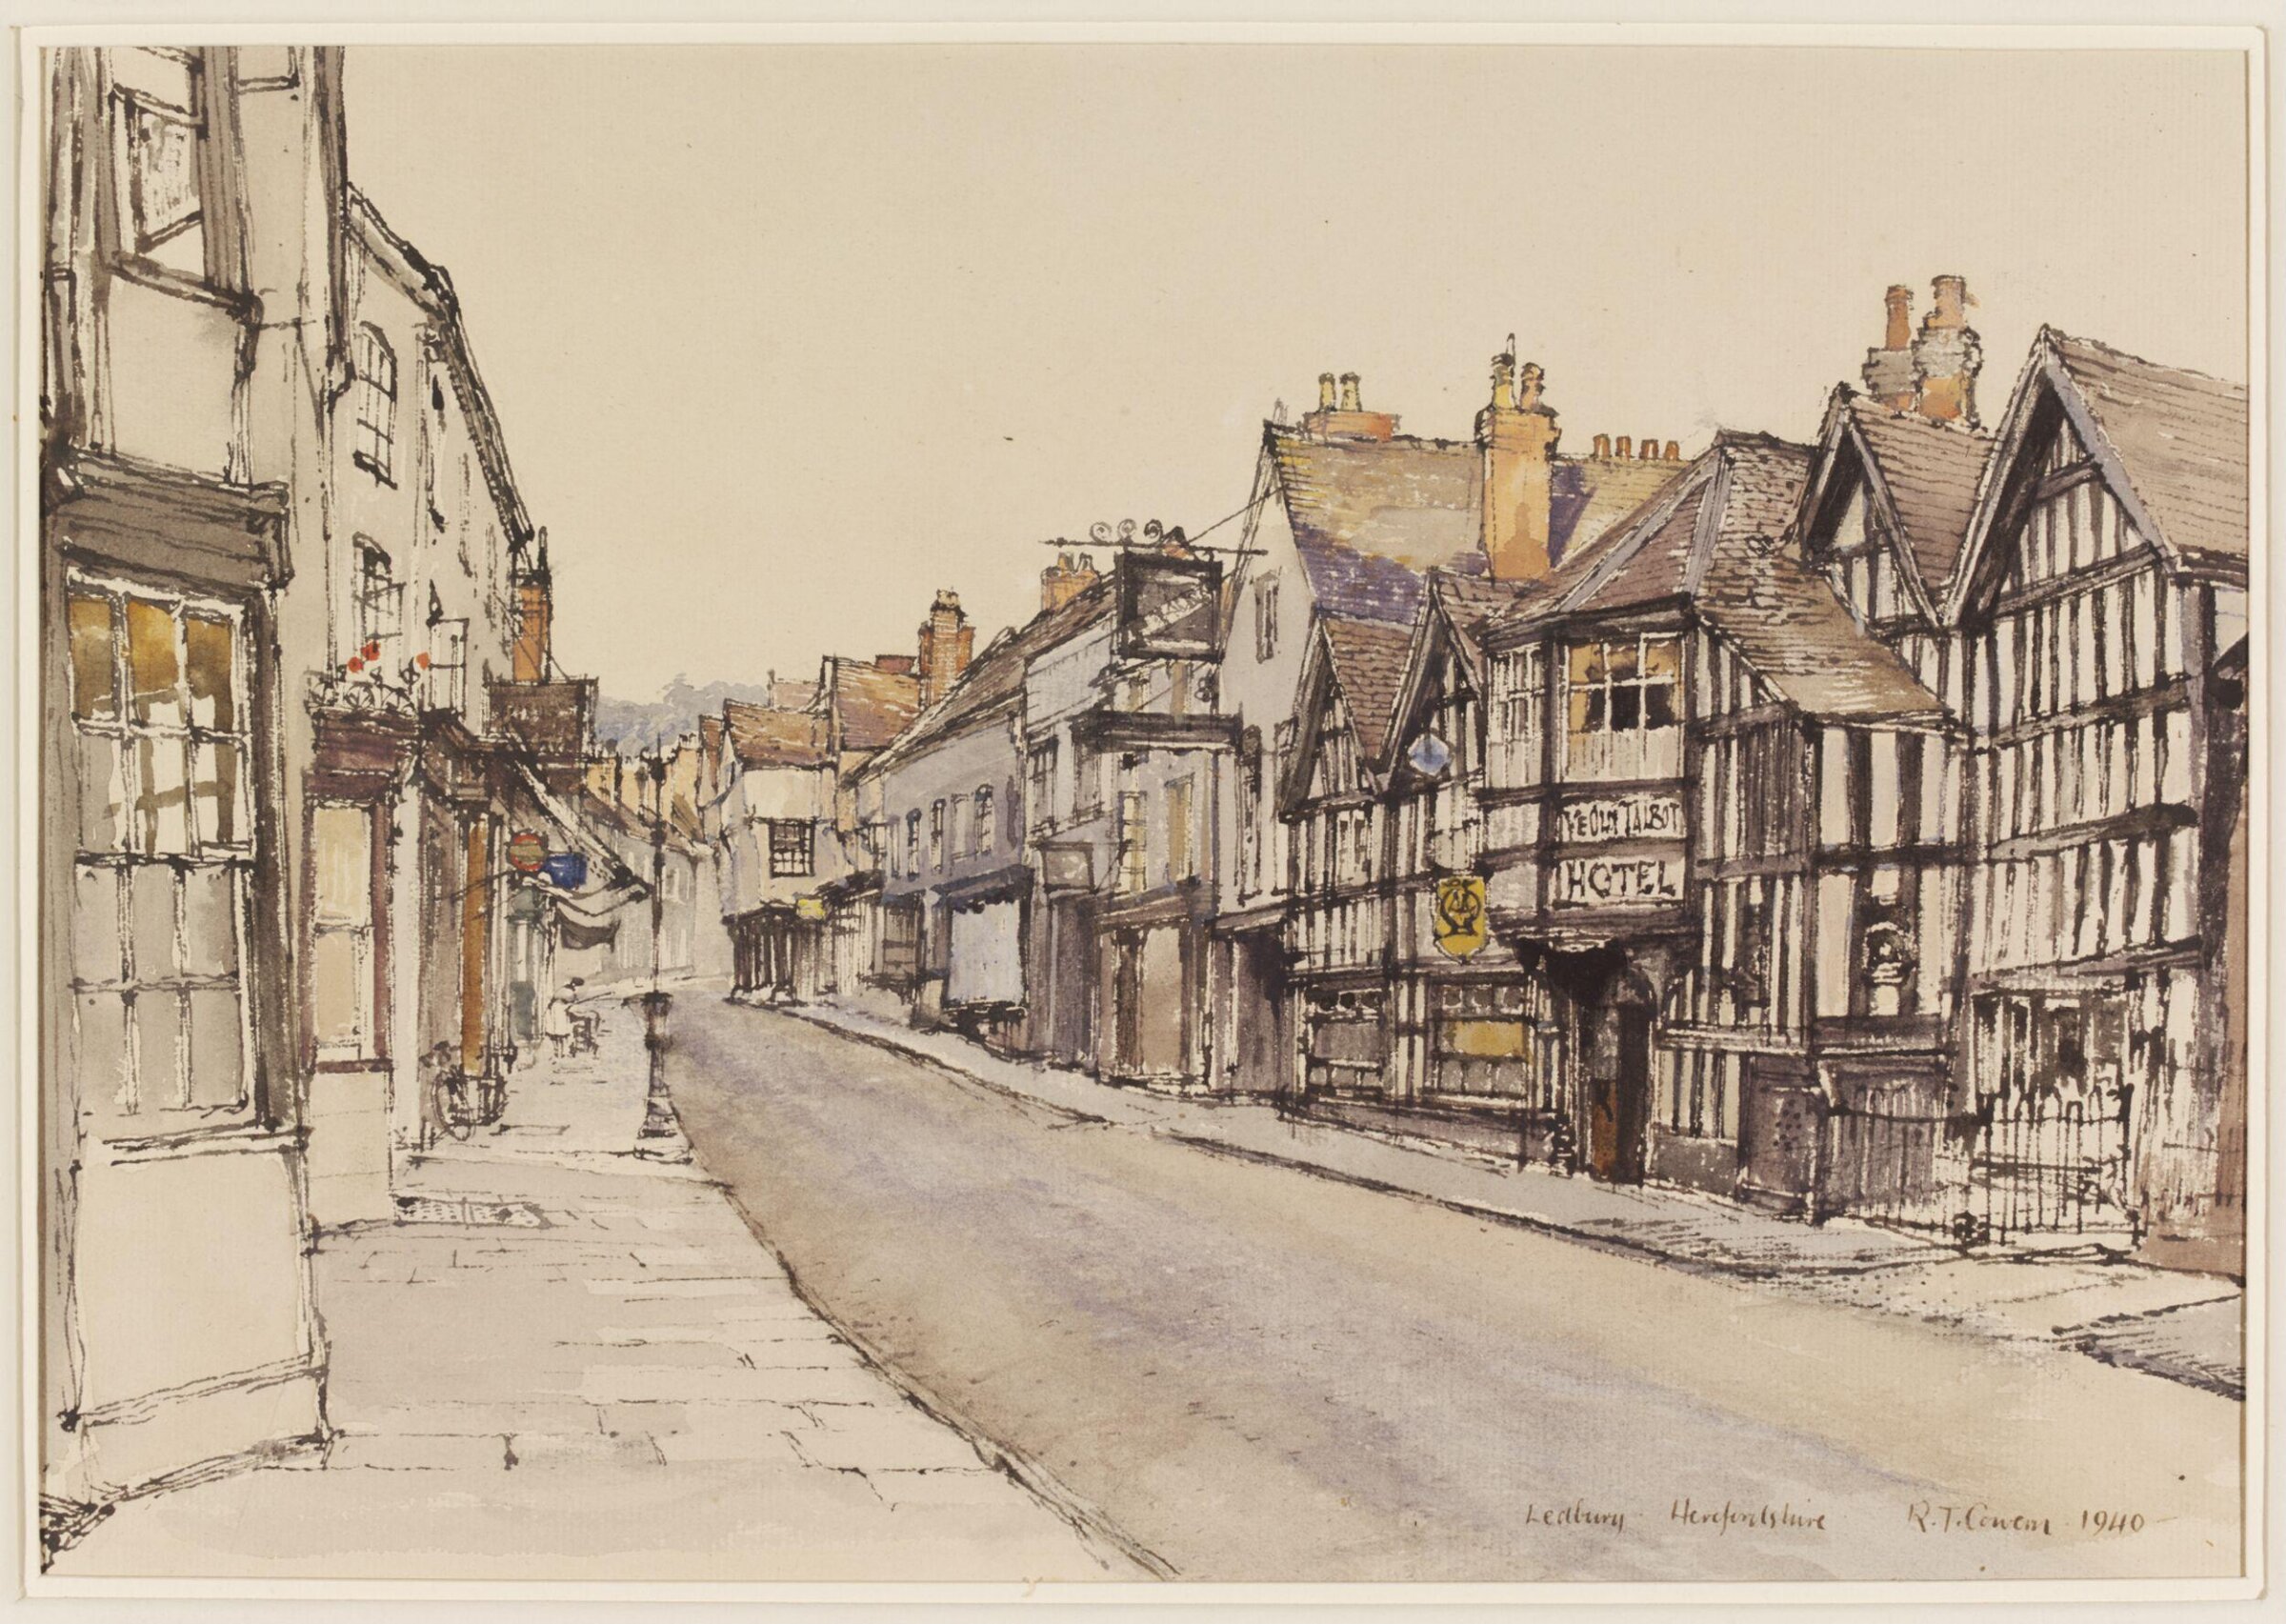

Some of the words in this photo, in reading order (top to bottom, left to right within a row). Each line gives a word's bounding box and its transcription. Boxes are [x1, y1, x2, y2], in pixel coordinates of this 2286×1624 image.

[1619, 800, 1680, 837] TALBOT
[1567, 860, 1676, 899] HOTEL
[1526, 1499, 1625, 1533] Ledbury
[2081, 1510, 2145, 1536] 1940
